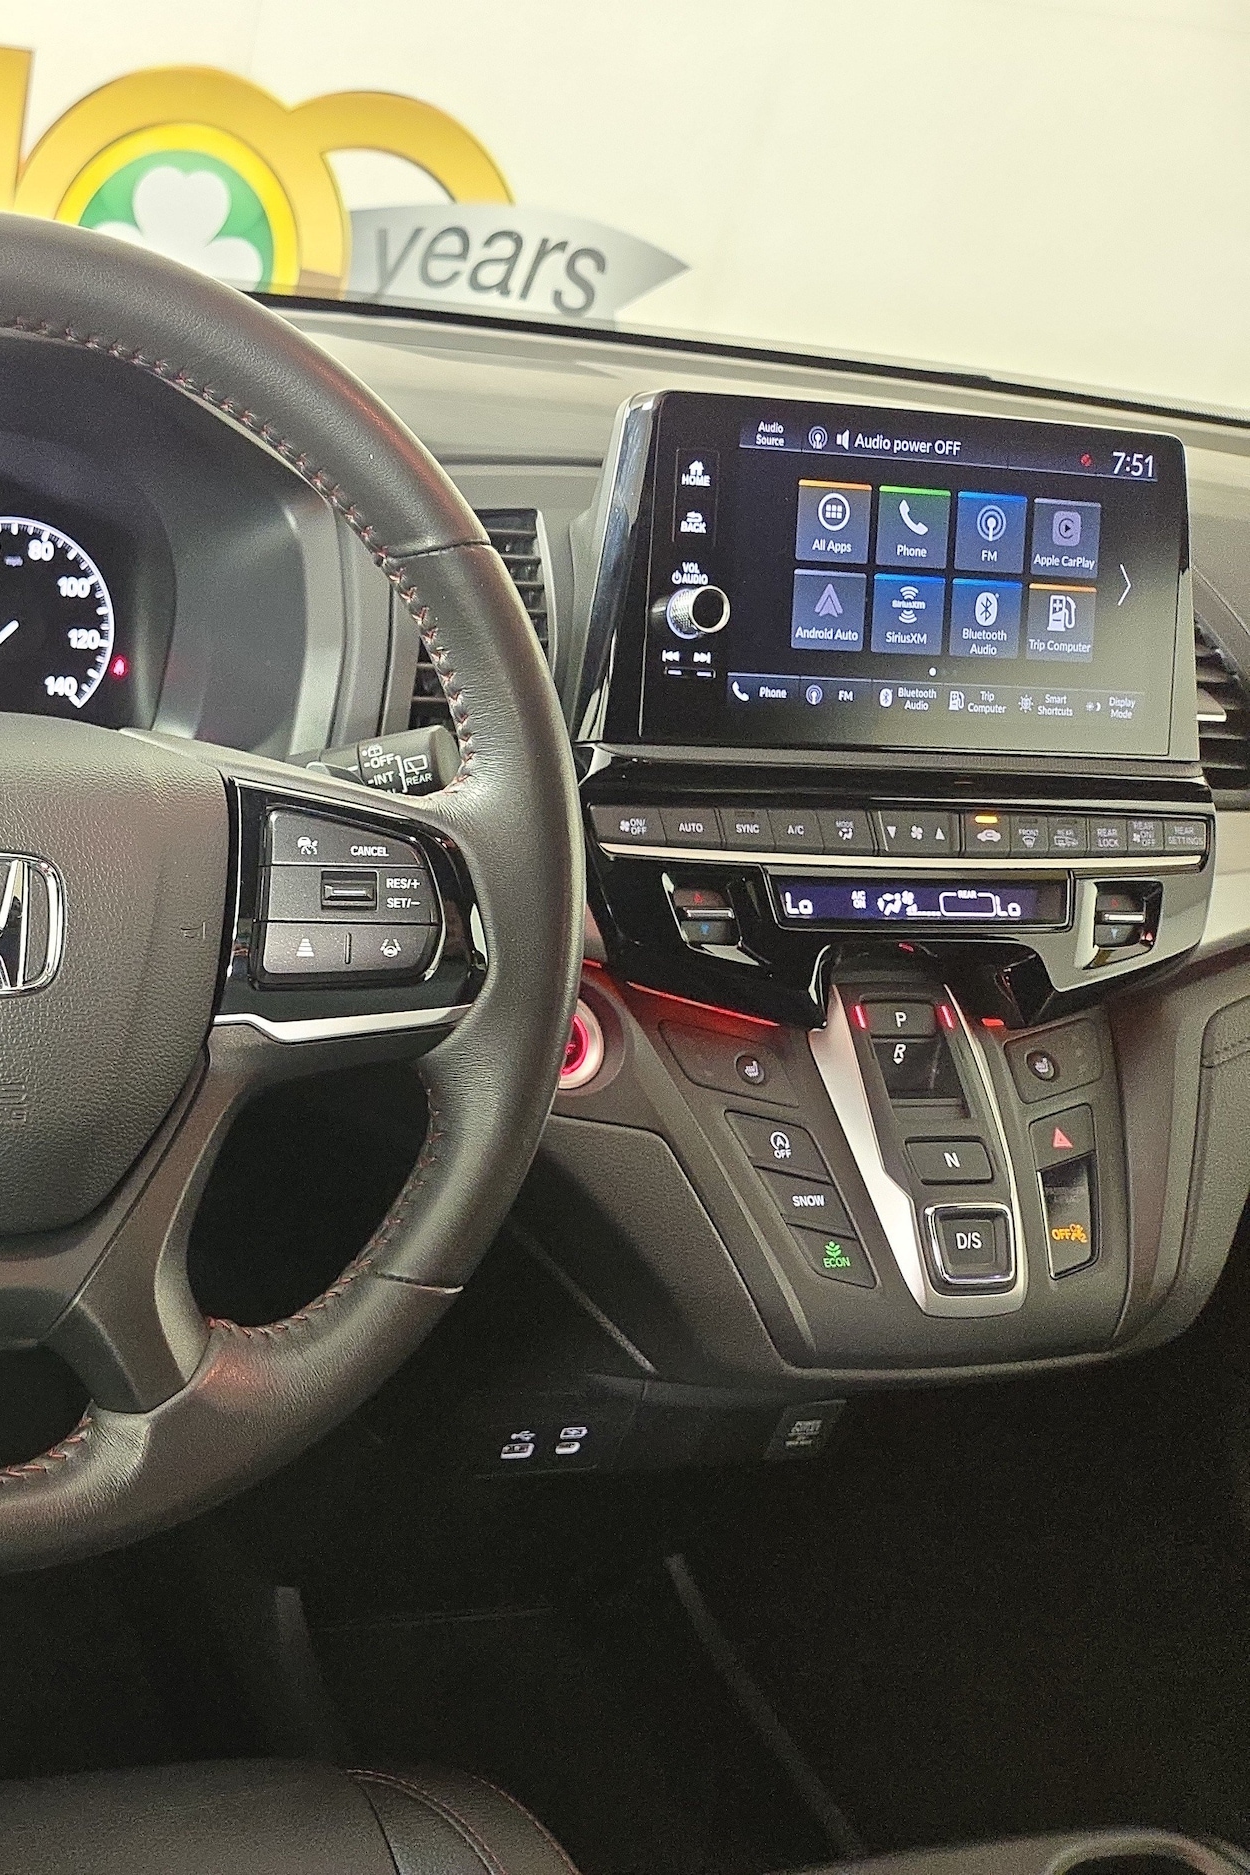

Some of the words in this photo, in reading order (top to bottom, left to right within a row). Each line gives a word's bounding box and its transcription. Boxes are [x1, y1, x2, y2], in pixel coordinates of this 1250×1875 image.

[369, 225, 608, 317] years
[757, 420, 784, 434] Audio
[755, 434, 785, 447] Source
[854, 432, 891, 451] Audio
[893, 438, 932, 456] power
[934, 440, 962, 455] OFF
[1112, 451, 1154, 477] 7:51
[681, 474, 711, 487] HOME
[679, 521, 707, 534] BACK
[27, 538, 55, 562] 80
[811, 538, 827, 551] All
[827, 540, 852, 555] Apps
[896, 544, 928, 557] Phone
[981, 549, 998, 562] FM
[1033, 553, 1060, 568] Apple
[1061, 555, 1096, 571] CarPlay
[682, 562, 700, 574] VOL
[681, 573, 709, 585] AUDIO
[57, 575, 91, 599] 100
[67, 627, 100, 650] 120
[795, 626, 833, 640] Android
[833, 627, 859, 641] Auto
[885, 631, 928, 645] SiriusXM
[961, 628, 1007, 642] Bluetooth
[969, 643, 998, 656] Audio
[1028, 638, 1046, 653] Trip
[1047, 640, 1092, 654] Computer
[44, 675, 78, 697] 140
[758, 685, 787, 699] Phone
[897, 686, 937, 699] Bluetooth
[838, 689, 854, 702] FM
[979, 690, 995, 703] Trip
[1044, 693, 1067, 705] Smart
[904, 699, 929, 711] Audio
[967, 702, 1007, 714] Computer
[1108, 696, 1137, 710] Display
[1037, 704, 1074, 717] Shortcuts
[1110, 708, 1133, 720] Mode
[370, 752, 395, 769] OFF
[373, 770, 395, 786] INT
[405, 772, 433, 787] REAR
[630, 826, 647, 836] OFF
[678, 821, 704, 833] AUTO
[735, 823, 760, 835] SYNC
[787, 824, 805, 835] A/C
[1098, 837, 1120, 848] LOCK
[1167, 835, 1205, 847] SETTINGS
[350, 845, 390, 858] CANCEL
[386, 878, 420, 890] RES/+
[851, 890, 867, 900] A/C
[957, 889, 978, 900] REAR
[852, 900, 867, 910] ON
[894, 1011, 908, 1028] P
[893, 1043, 907, 1059] R
[773, 1148, 792, 1159] OFF
[944, 1152, 960, 1168] N
[792, 1195, 825, 1207] SNOW
[955, 1231, 983, 1250] D/S
[1051, 1228, 1071, 1241] OFF
[823, 1256, 851, 1269] ECON
